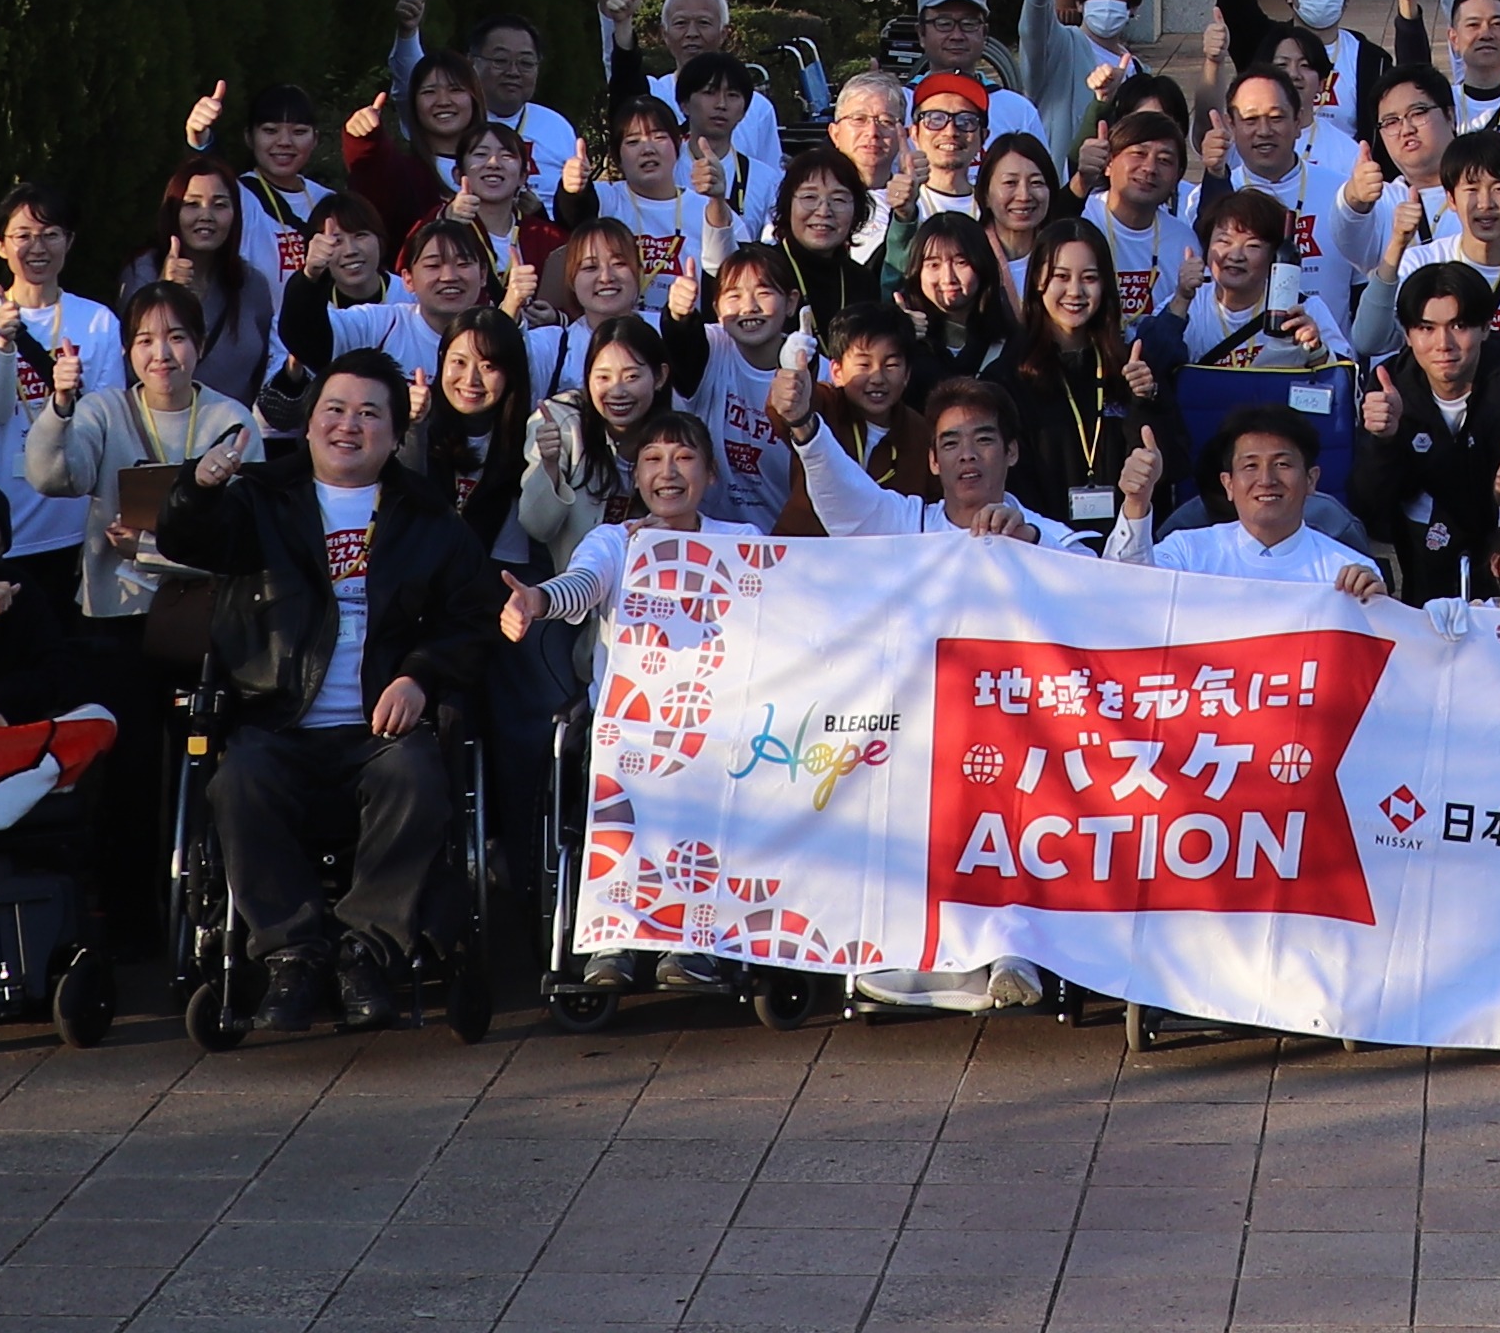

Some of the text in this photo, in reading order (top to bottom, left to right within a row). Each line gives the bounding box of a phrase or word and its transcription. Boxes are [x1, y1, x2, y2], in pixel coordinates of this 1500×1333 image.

[642, 259, 675, 271] TION
[1120, 286, 1141, 298] スケ
[329, 560, 367, 575] TION
[974, 659, 1320, 720] 地域を元気に!
[824, 714, 901, 733] B.LEAGUE
[727, 701, 891, 812] Hope
[1015, 730, 1256, 802] バスケ
[955, 811, 1306, 881] ACTION
[1375, 834, 1423, 851] NISSAY
